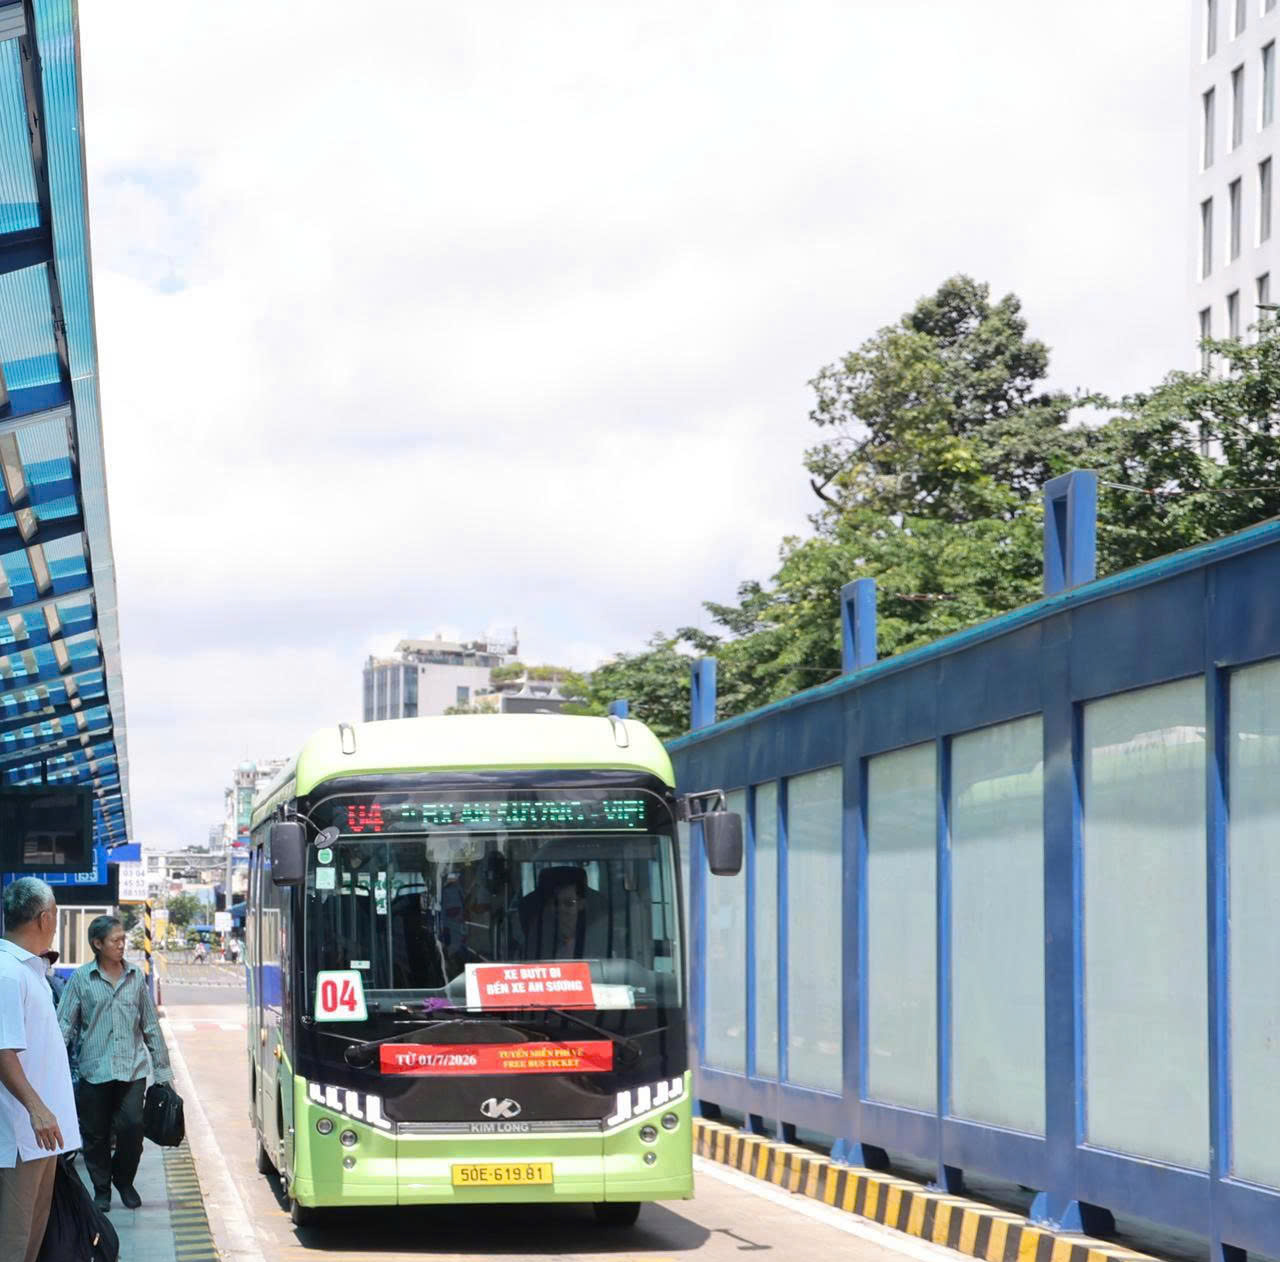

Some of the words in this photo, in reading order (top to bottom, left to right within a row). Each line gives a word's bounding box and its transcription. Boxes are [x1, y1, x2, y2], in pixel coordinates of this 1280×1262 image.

[504, 969, 518, 980] XE
[511, 982, 526, 993] XE
[528, 981, 544, 992] AN
[321, 979, 357, 1013] 04
[395, 1051, 417, 1066] TỪ
[419, 1054, 477, 1067] 01/7/2026
[503, 1060, 527, 1068] FREE
[546, 1059, 580, 1067] TICKET
[471, 1123, 495, 1133] KIM
[497, 1122, 529, 1132] LONG
[461, 1167, 543, 1181] 50E-619.81
